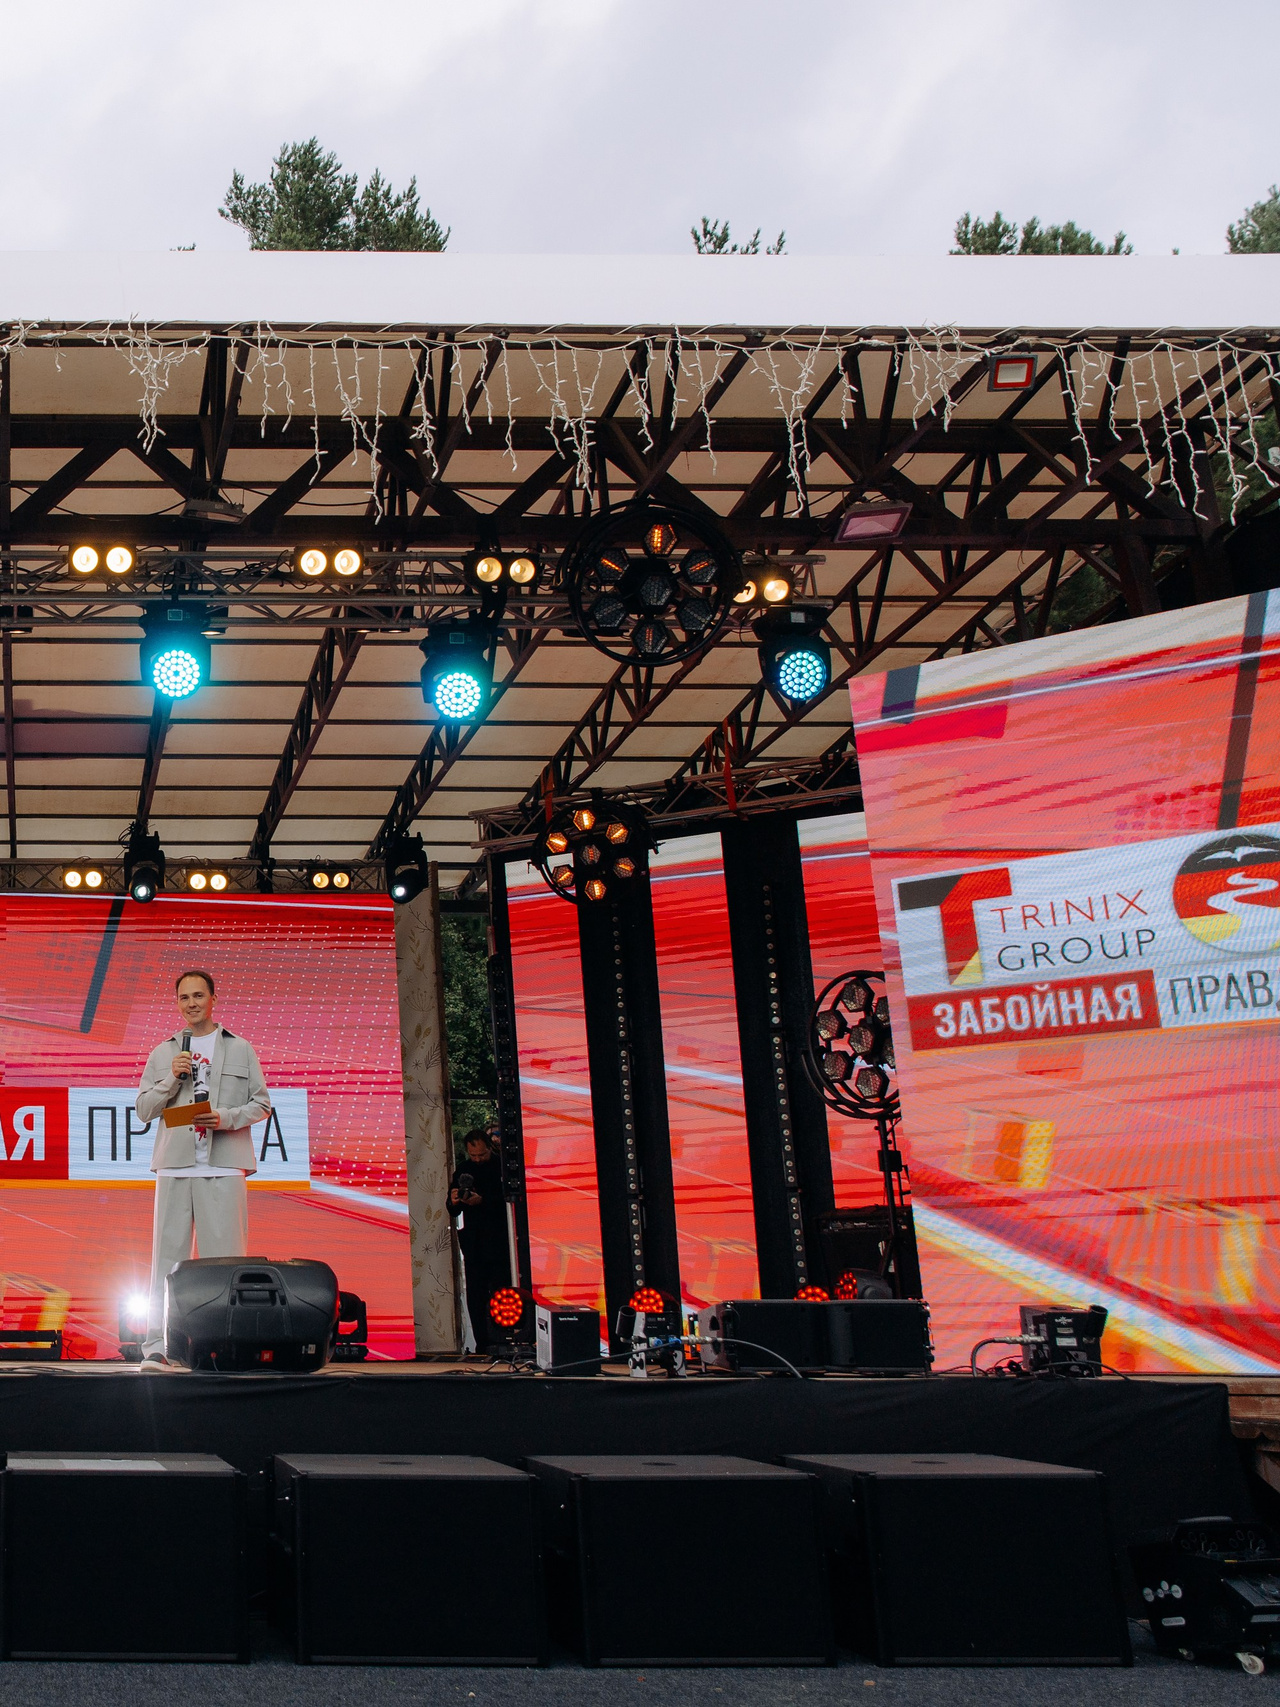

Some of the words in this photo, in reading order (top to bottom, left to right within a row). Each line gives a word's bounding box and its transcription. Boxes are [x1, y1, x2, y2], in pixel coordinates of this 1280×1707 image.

[990, 889, 1148, 934] TRINIX
[997, 928, 1156, 971] GROUP
[933, 983, 1144, 1039] ЗАБОЙНАЯ
[1169, 969, 1280, 1015] ПРАВ
[88, 1106, 289, 1162] ПРА
